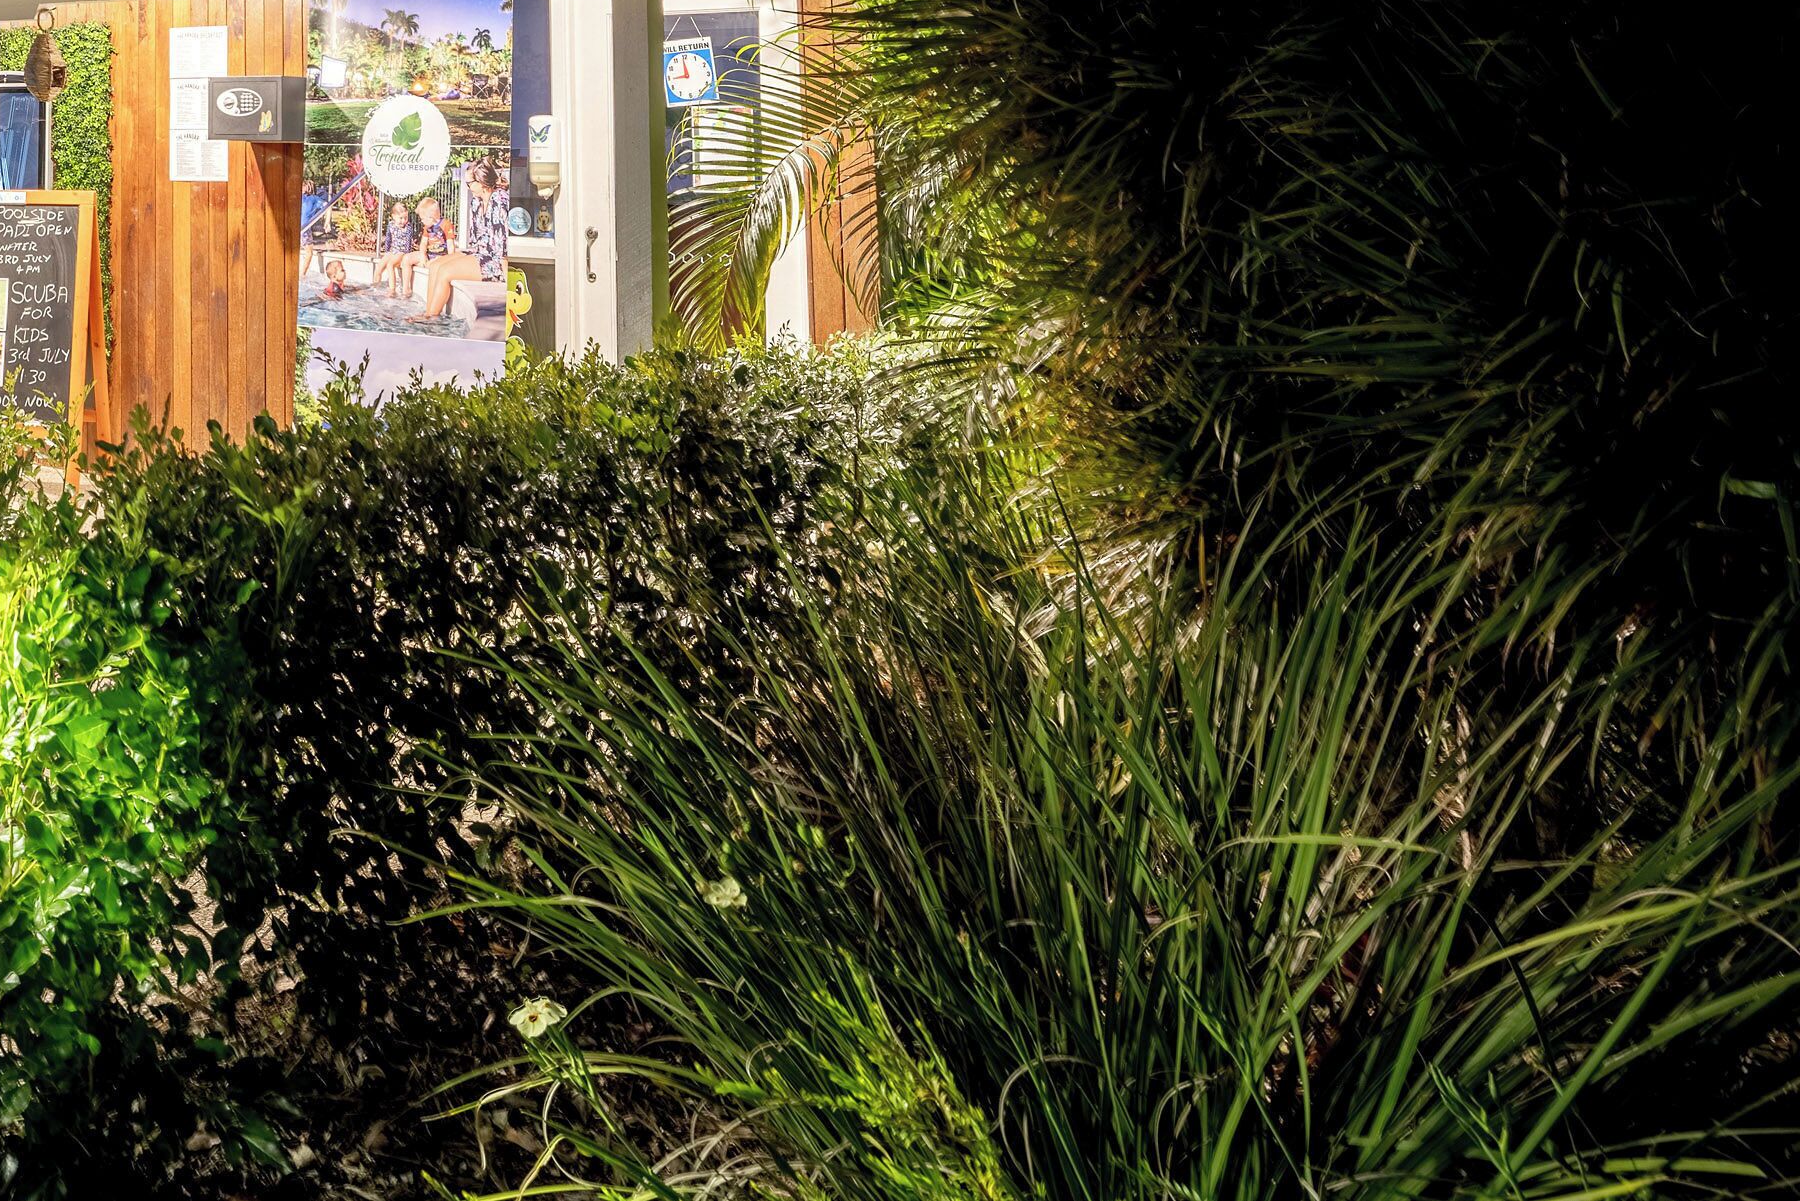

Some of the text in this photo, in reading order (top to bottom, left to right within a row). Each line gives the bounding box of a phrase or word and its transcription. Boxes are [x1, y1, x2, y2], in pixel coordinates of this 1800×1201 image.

[678, 42, 710, 52] RETURN
[369, 144, 424, 172] Tropical
[36, 224, 72, 236] OPEN
[23, 254, 51, 263] JULY
[26, 265, 40, 274] PM
[10, 281, 68, 304] SCUBA
[20, 306, 53, 320] FOR
[14, 325, 49, 344] KIDS
[8, 347, 70, 364] 3rd JULY
